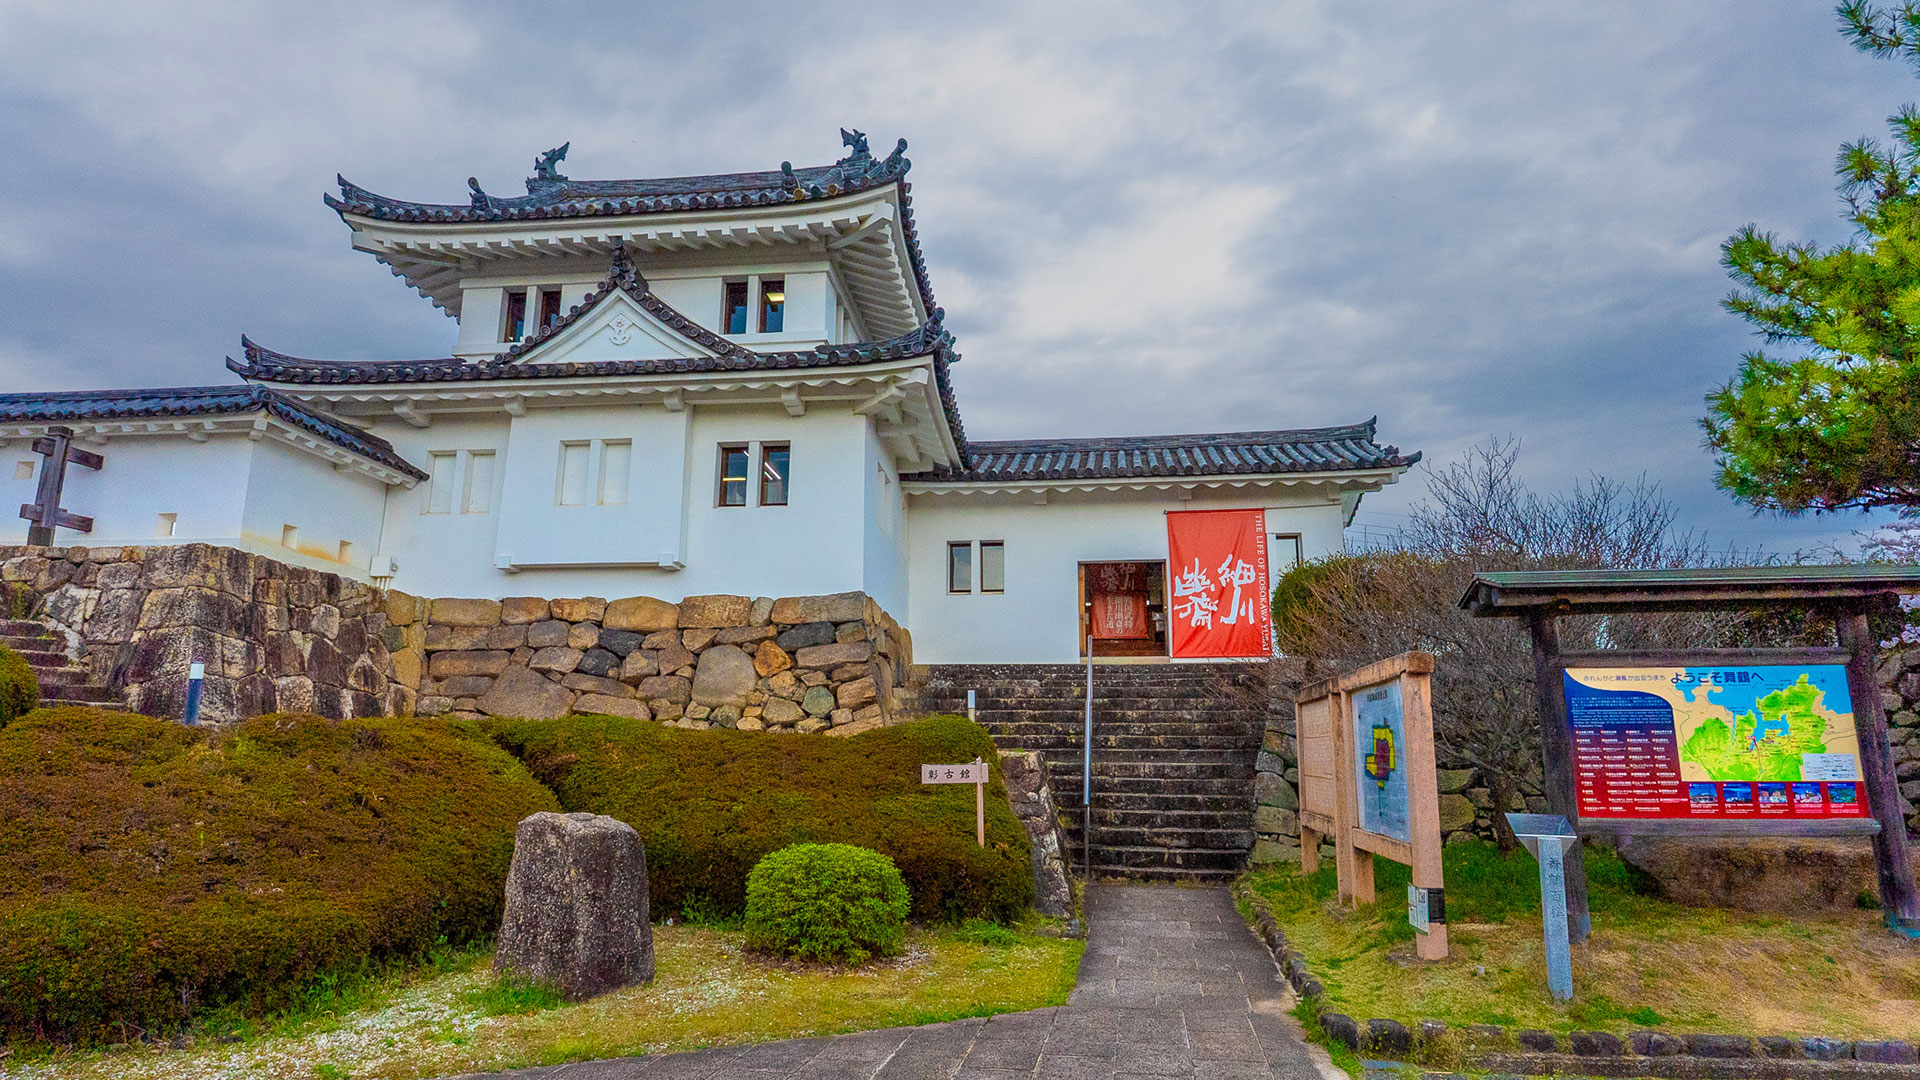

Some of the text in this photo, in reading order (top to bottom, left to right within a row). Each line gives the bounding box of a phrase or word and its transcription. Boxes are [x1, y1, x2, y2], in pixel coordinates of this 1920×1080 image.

[1255, 514, 1270, 651] THE LIFE OF HOSOKAWA YUSAI
[1670, 671, 1764, 684] ようこそ舞鶴へ
[928, 769, 971, 780] 彰古館
